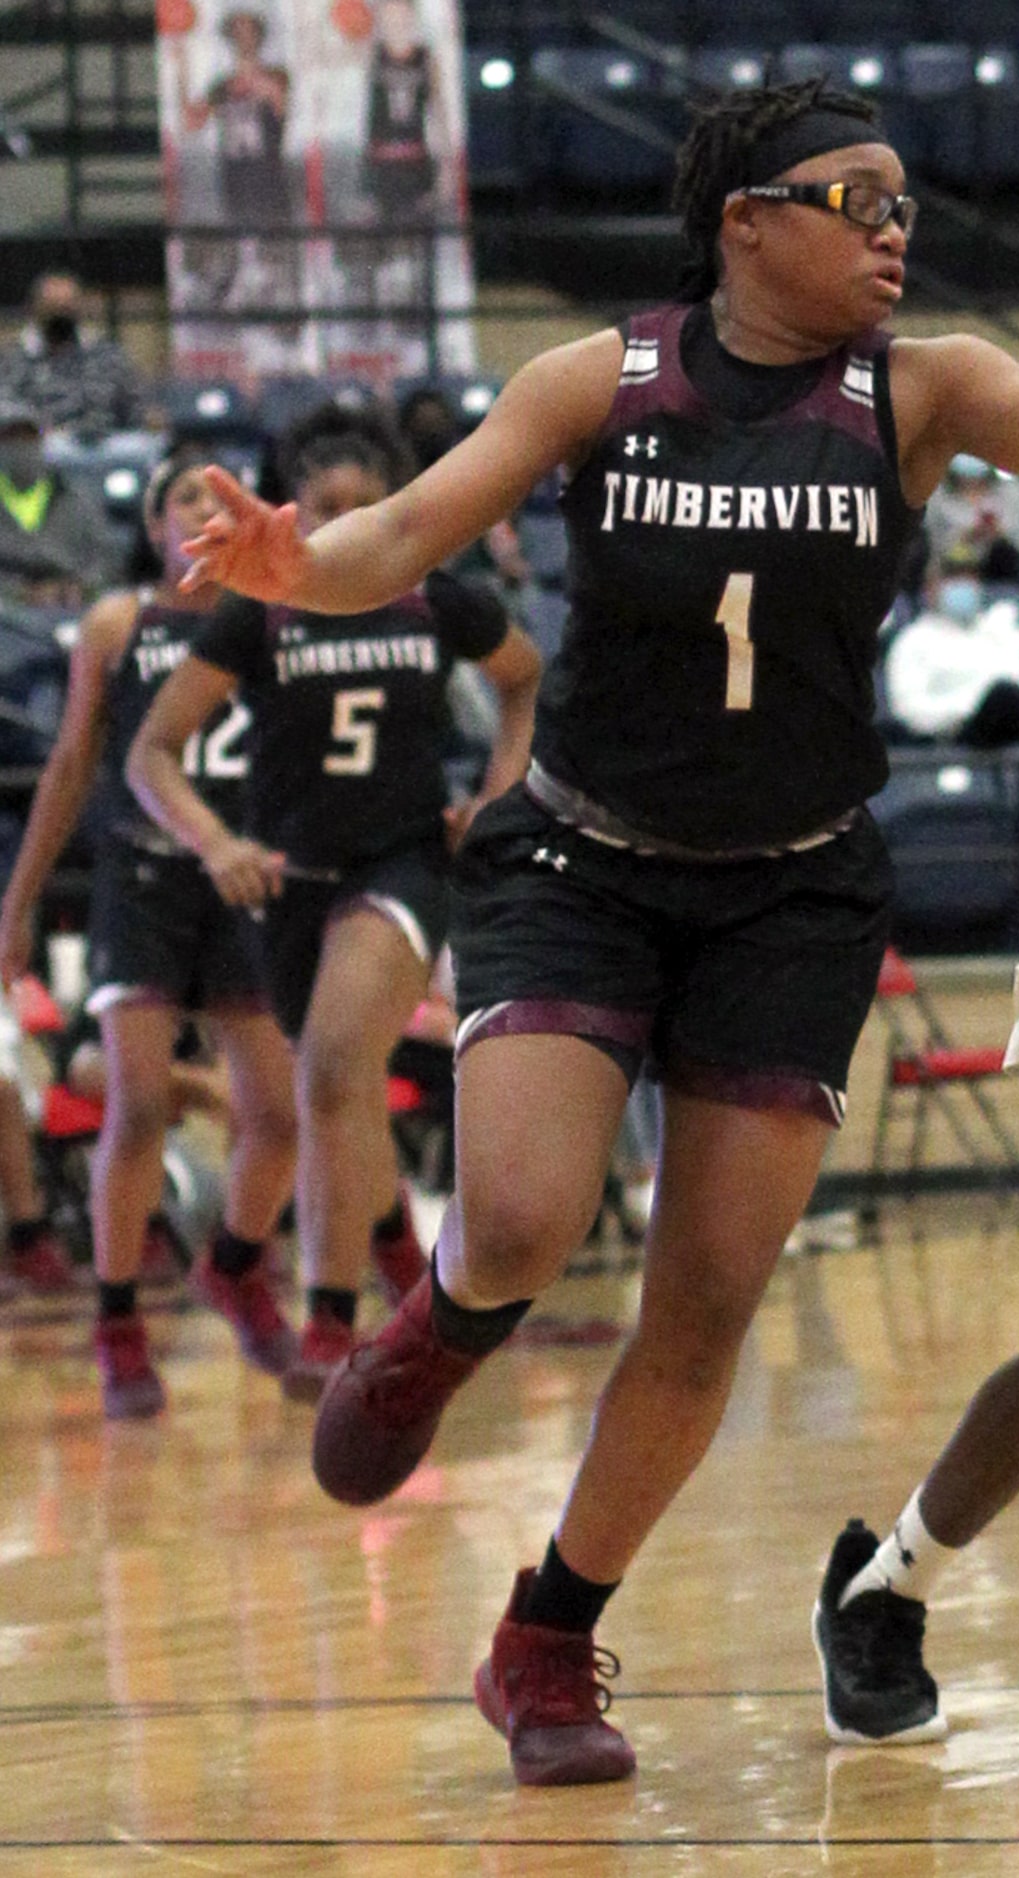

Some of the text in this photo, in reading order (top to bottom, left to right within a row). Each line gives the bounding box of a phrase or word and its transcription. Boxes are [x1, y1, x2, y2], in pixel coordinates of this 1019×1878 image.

[601, 471, 879, 547] TIMBERVIEW
[716, 573, 755, 710] 1
[323, 688, 386, 775] 5
